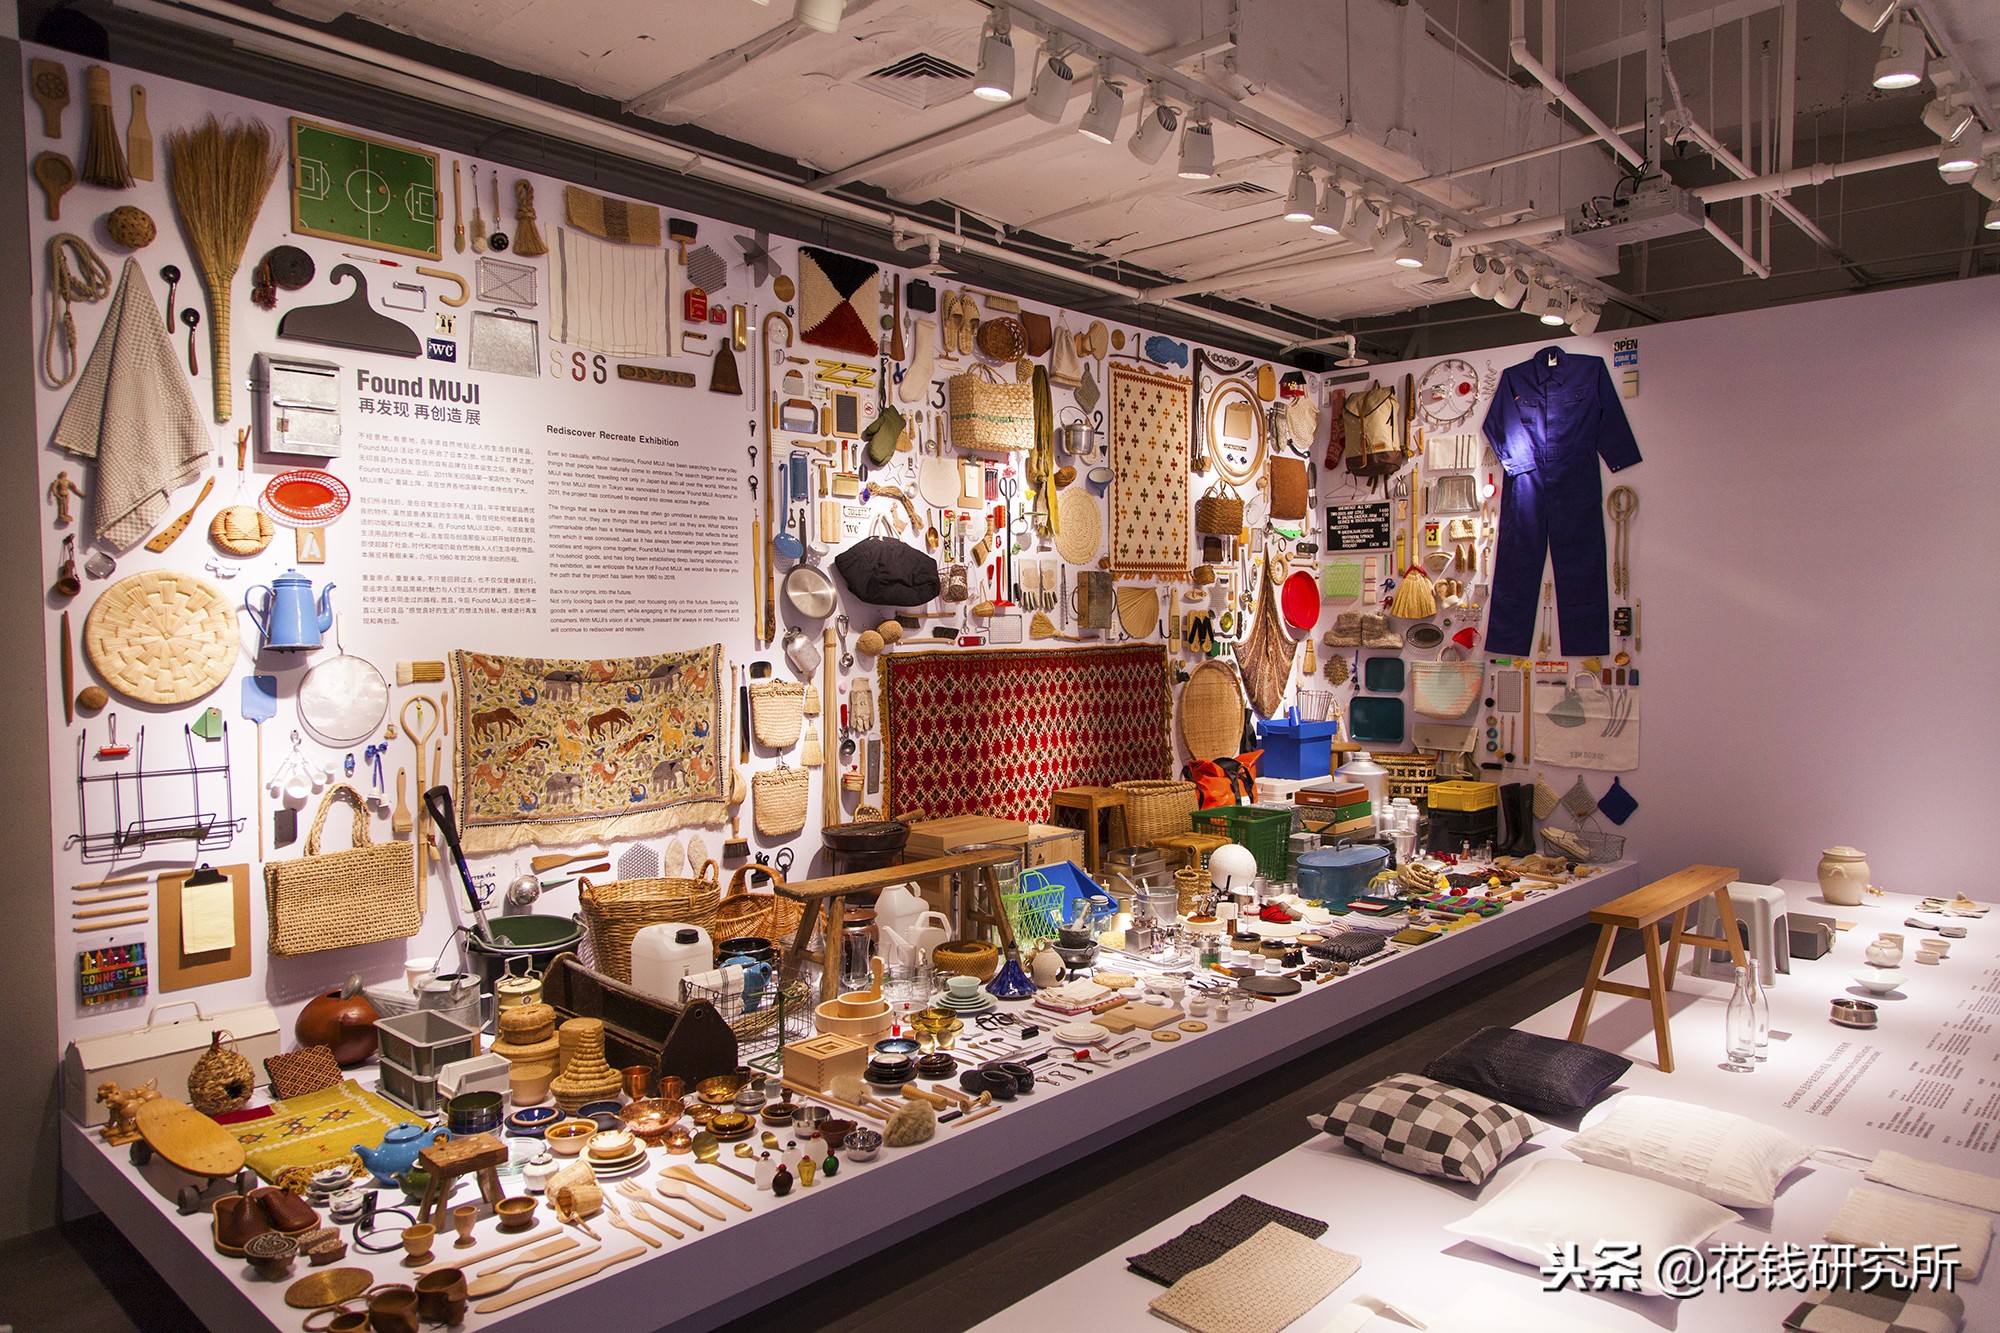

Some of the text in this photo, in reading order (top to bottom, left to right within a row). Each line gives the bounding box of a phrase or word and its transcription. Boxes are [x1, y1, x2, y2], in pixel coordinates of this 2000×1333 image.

[1614, 339, 1638, 352] OPEN
[357, 369, 480, 404] Found MUJI
[358, 397, 481, 426] 再发现 再创造 展
[547, 425, 679, 446] Rediscover Recreate Exhibition
[301, 532, 321, 559] A
[1429, 529, 1436, 541] 3
[83, 982, 114, 993] CRAYON
